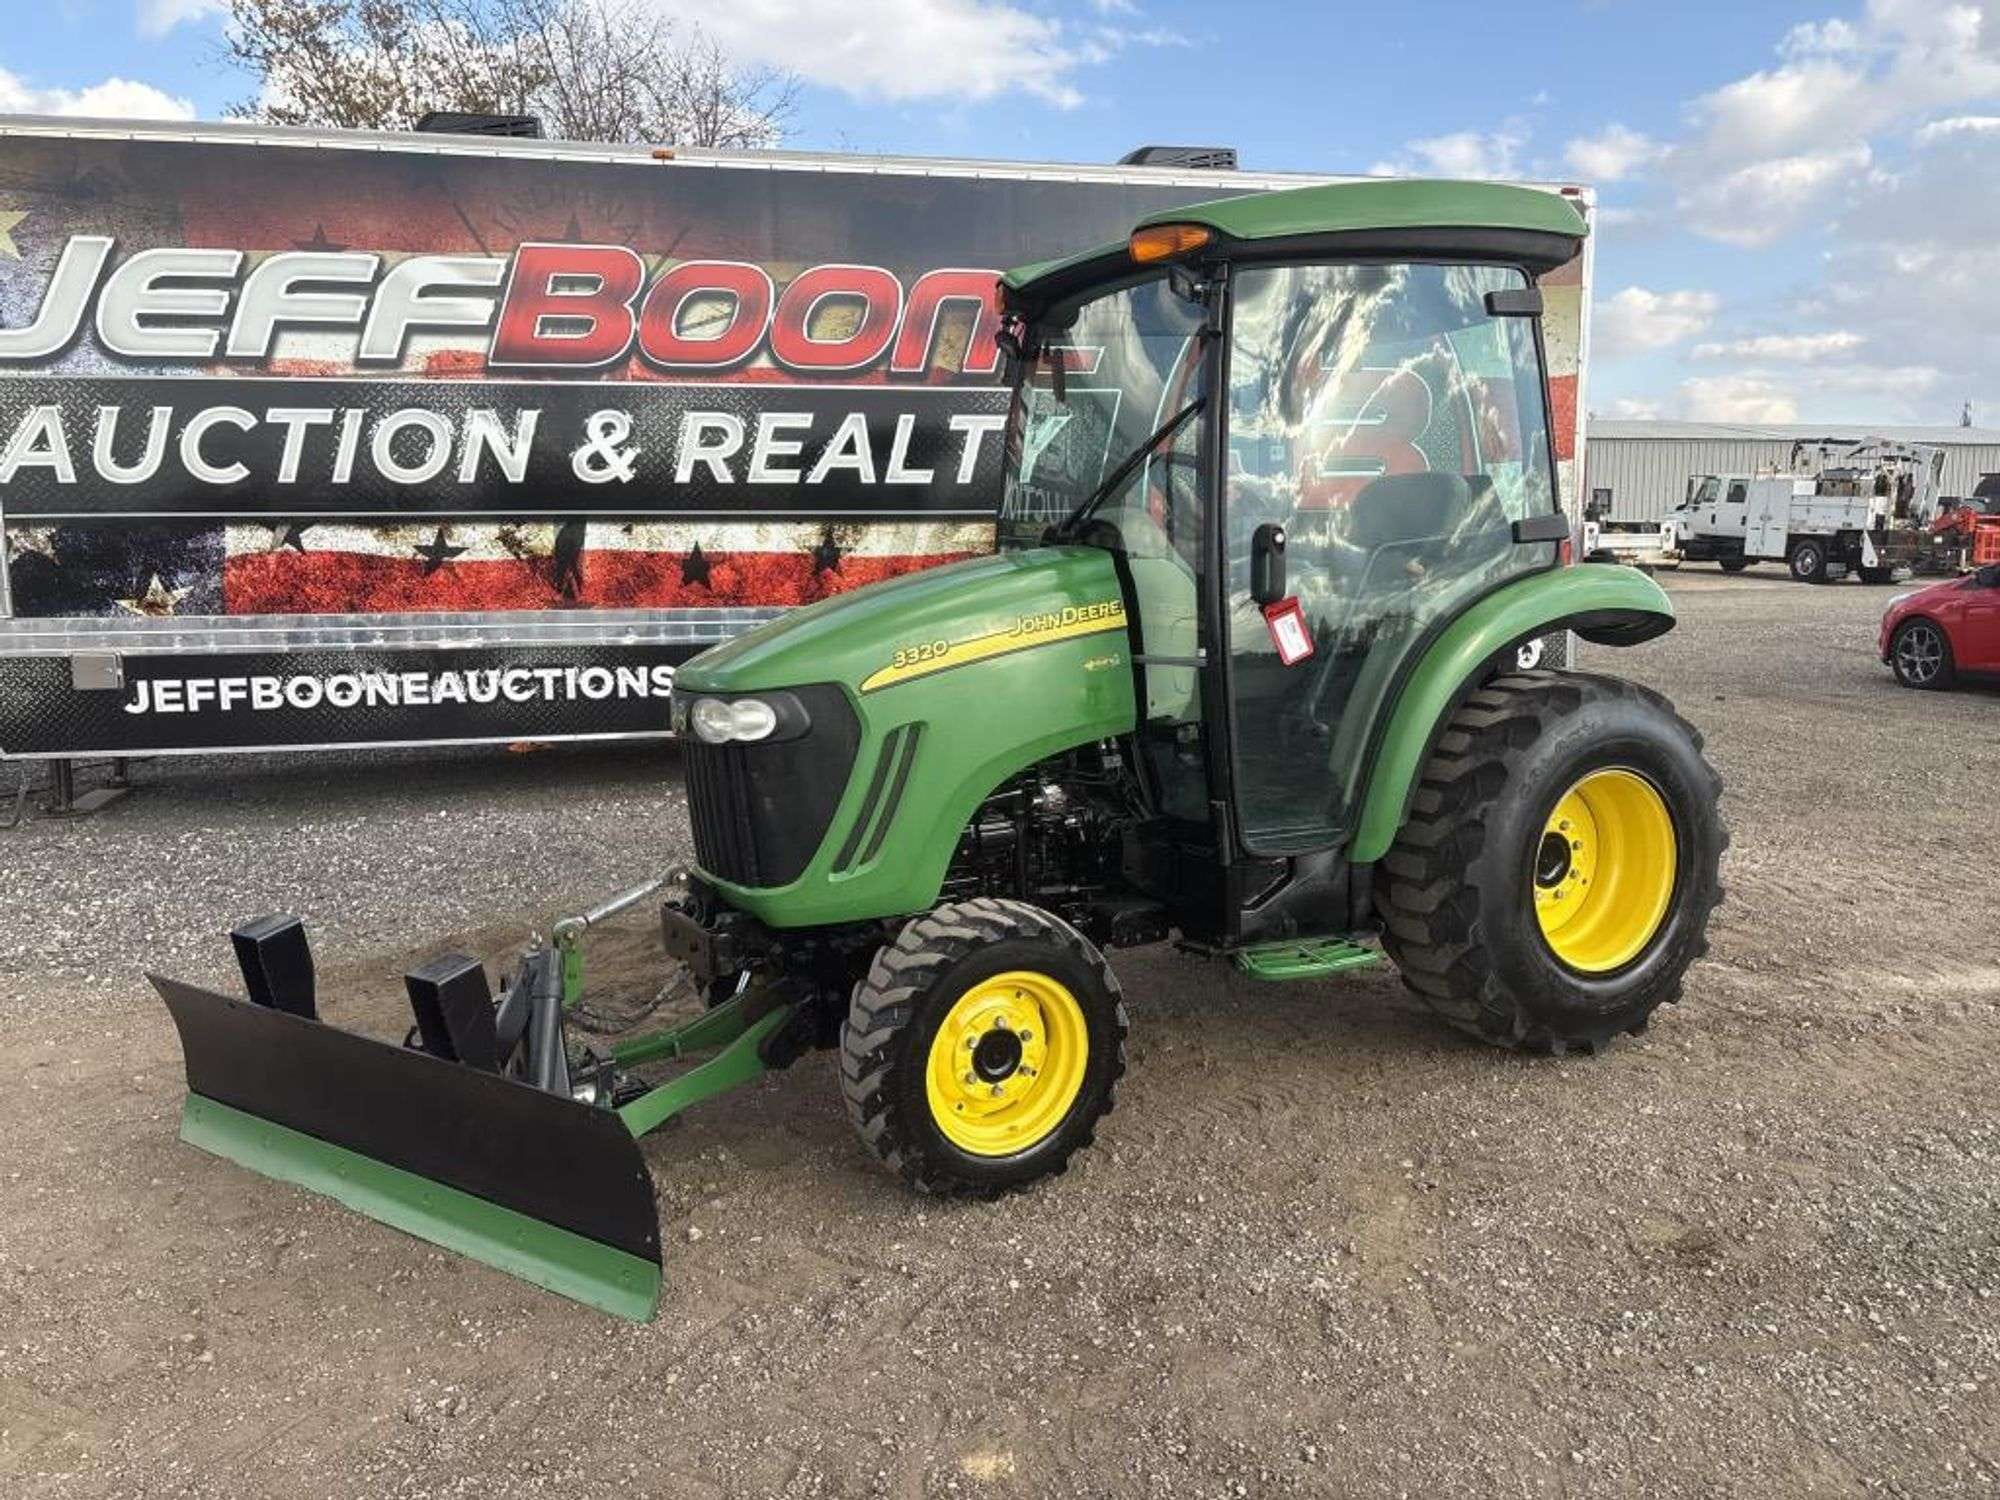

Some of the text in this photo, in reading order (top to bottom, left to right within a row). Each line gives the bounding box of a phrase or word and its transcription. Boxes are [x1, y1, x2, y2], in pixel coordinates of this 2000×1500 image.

[0, 406, 541, 484] AUCTION
[571, 409, 640, 484] &
[893, 640, 949, 669] 3320
[125, 665, 676, 714] JEFFBOONEAUCTIONS
